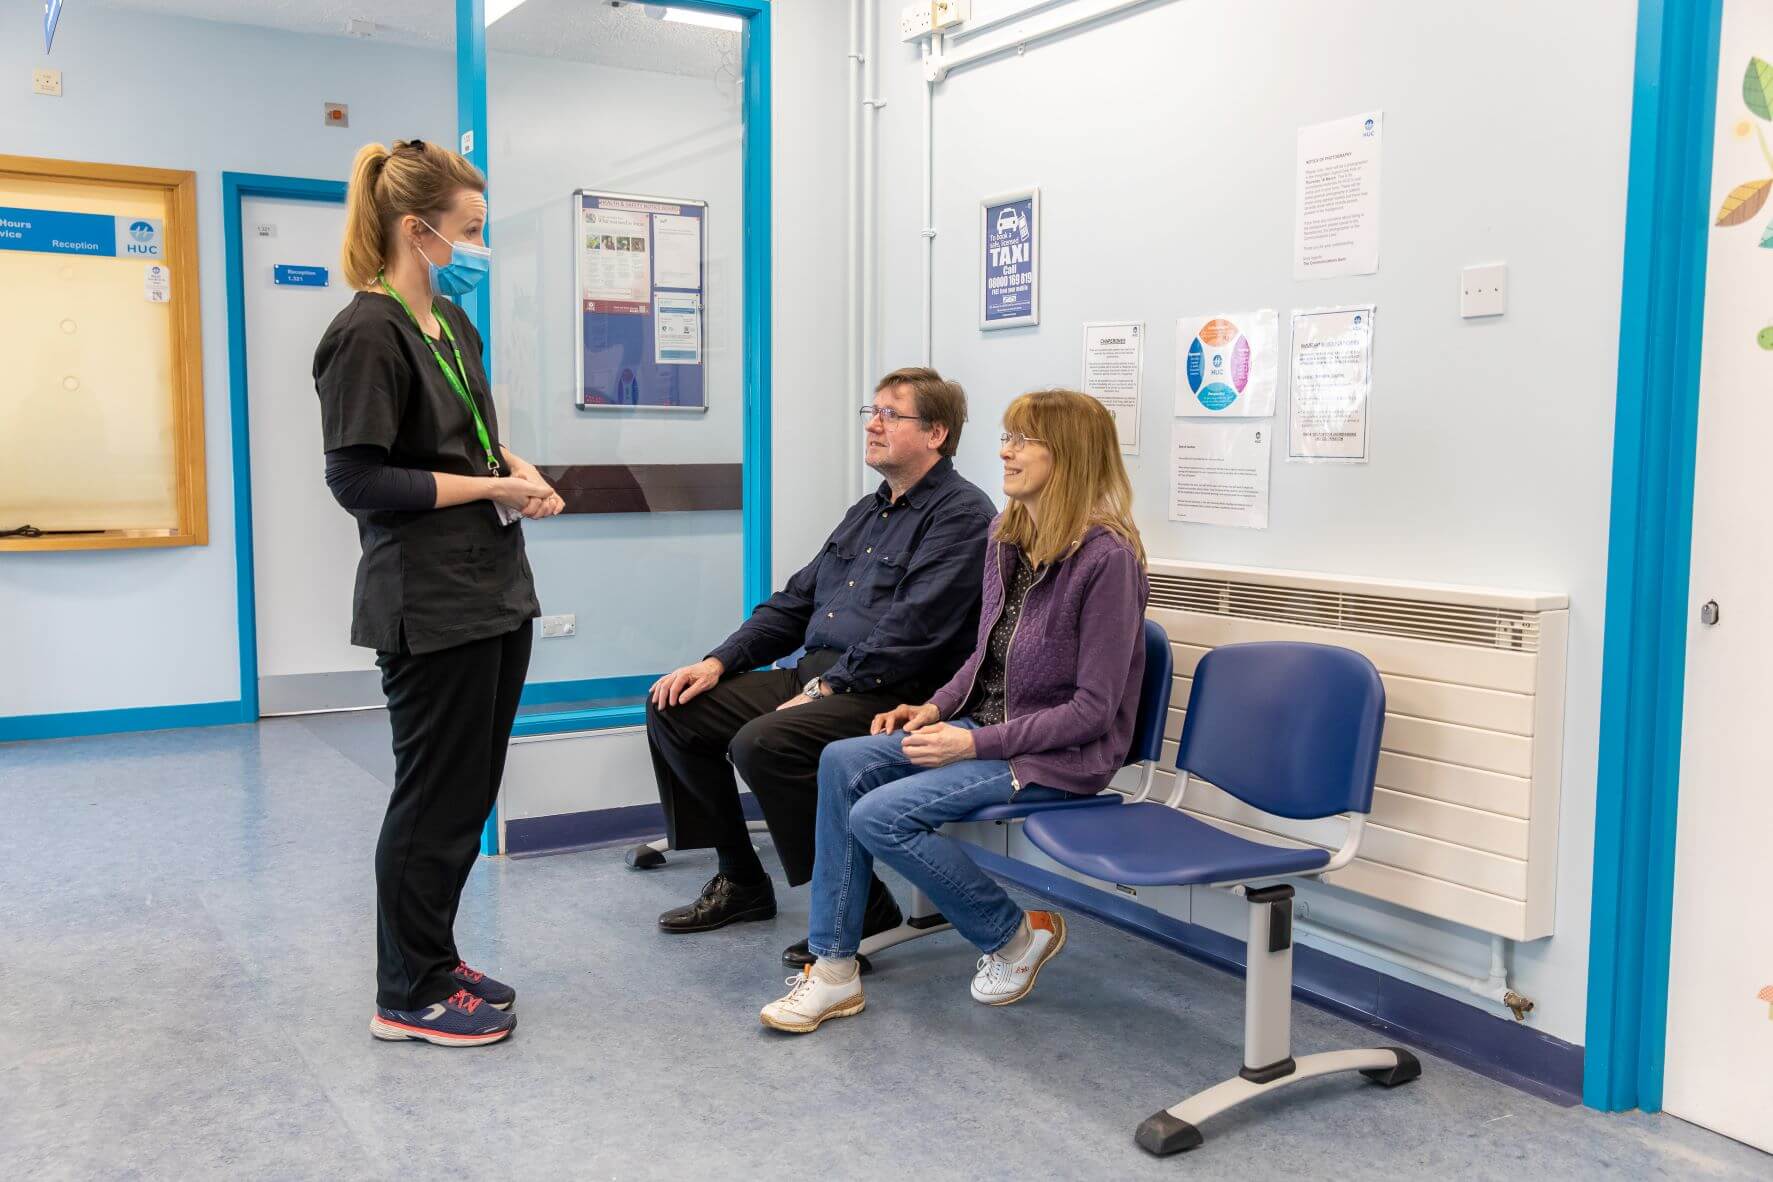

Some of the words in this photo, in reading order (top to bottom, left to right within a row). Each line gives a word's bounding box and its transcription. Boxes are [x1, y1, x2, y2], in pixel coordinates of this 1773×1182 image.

[997, 232, 1008, 240] book
[52, 239, 99, 251] Reception
[127, 243, 158, 255] HUC
[990, 242, 1030, 267] TAXI
[1003, 264, 1017, 275] Call
[1008, 273, 1020, 286] 169
